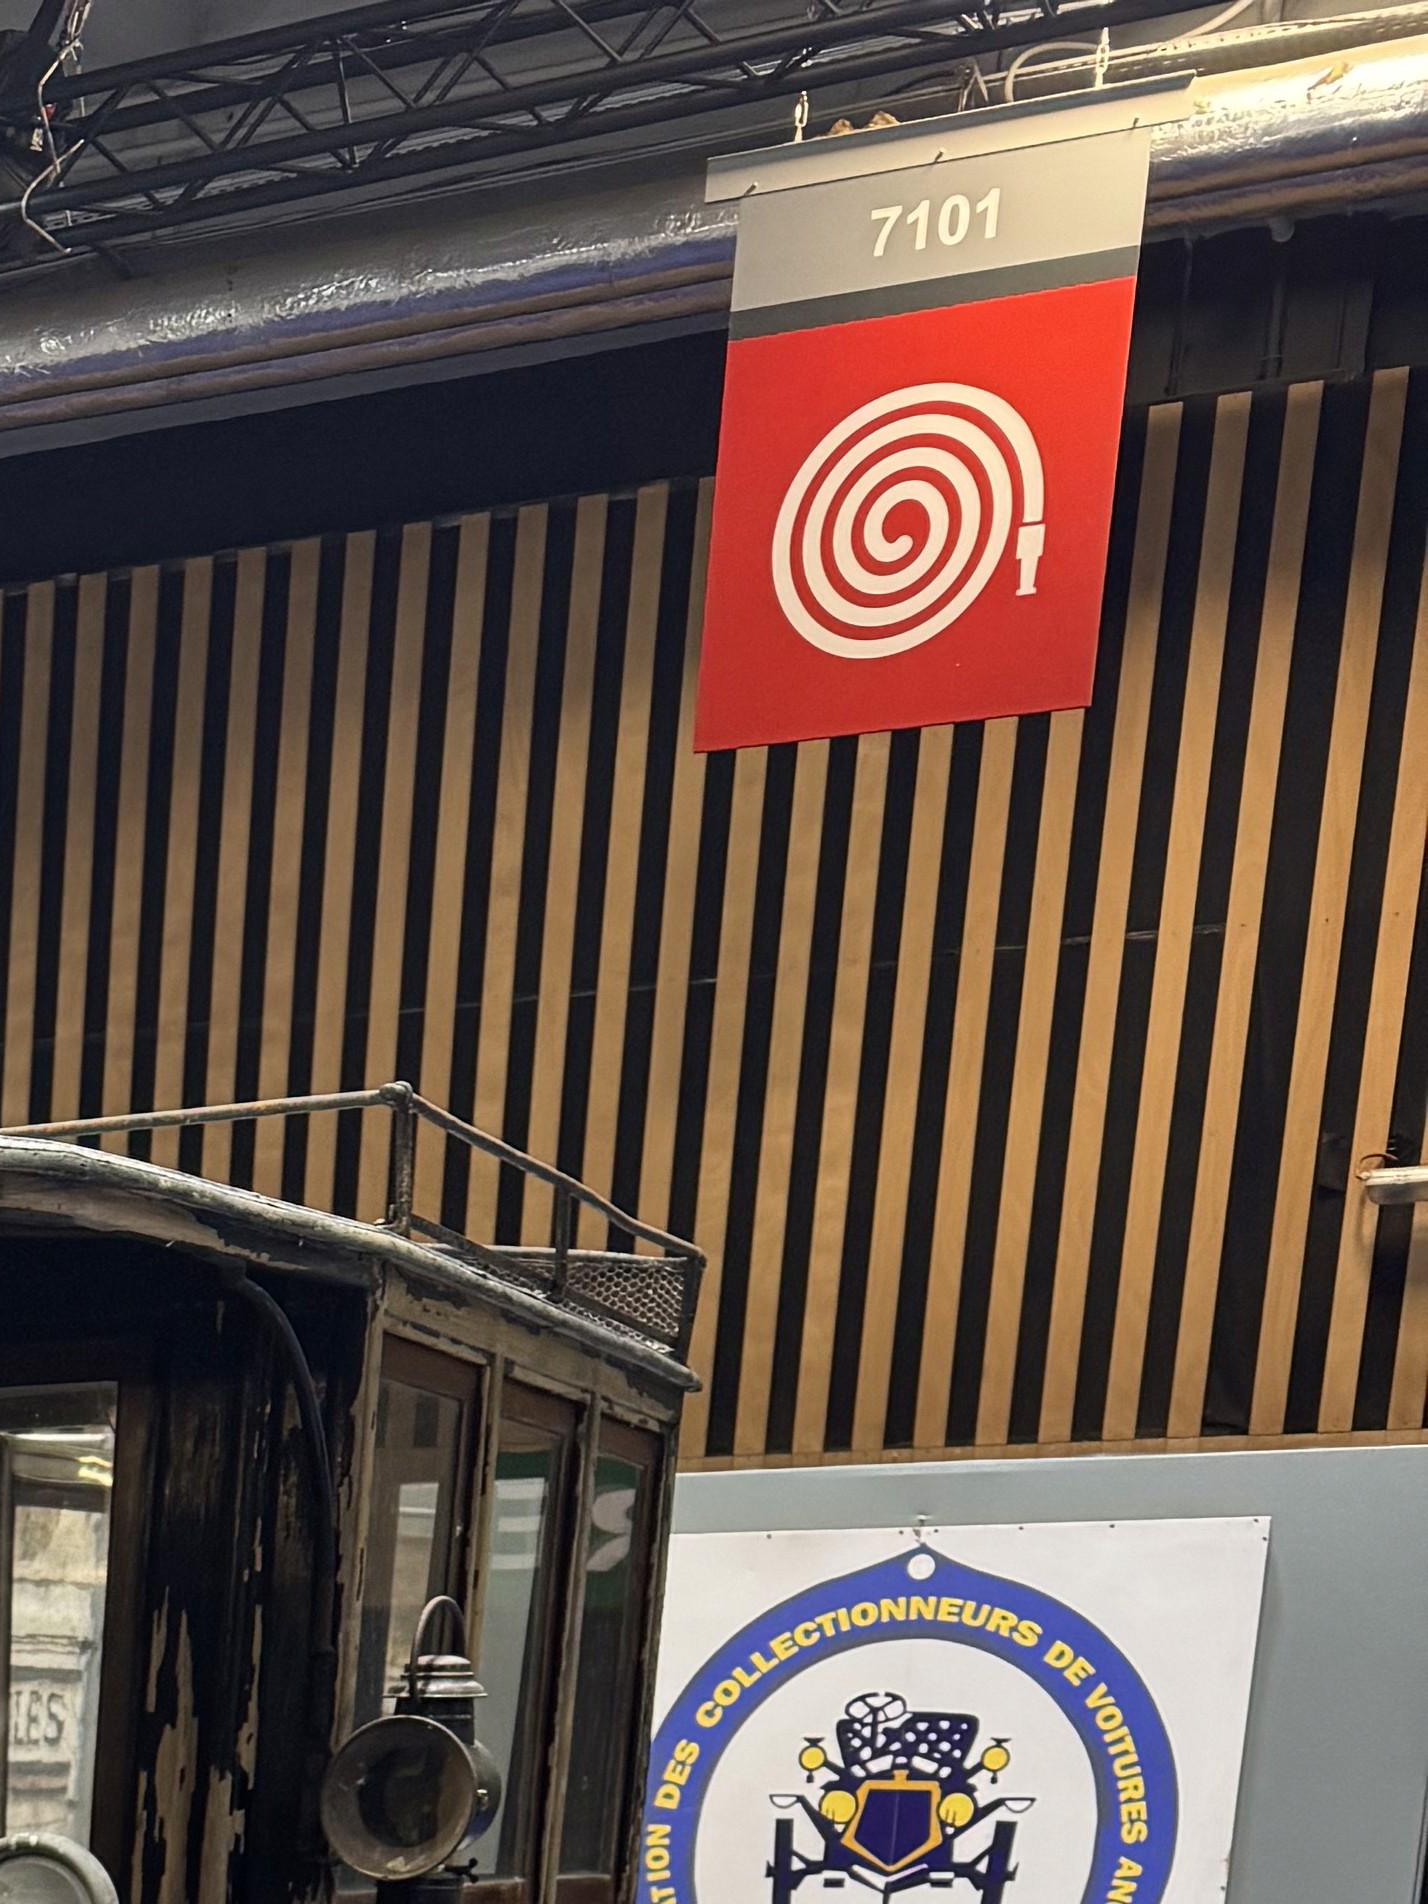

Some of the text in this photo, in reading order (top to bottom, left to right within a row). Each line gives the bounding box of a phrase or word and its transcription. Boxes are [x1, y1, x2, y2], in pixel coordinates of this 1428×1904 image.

[870, 187, 1002, 257] 7101
[654, 1738, 702, 1813] DES
[694, 1595, 1044, 1730] COLLECTIONNEURS
[1042, 1640, 1093, 1688] DE
[1084, 1681, 1149, 1846] VOITURES
